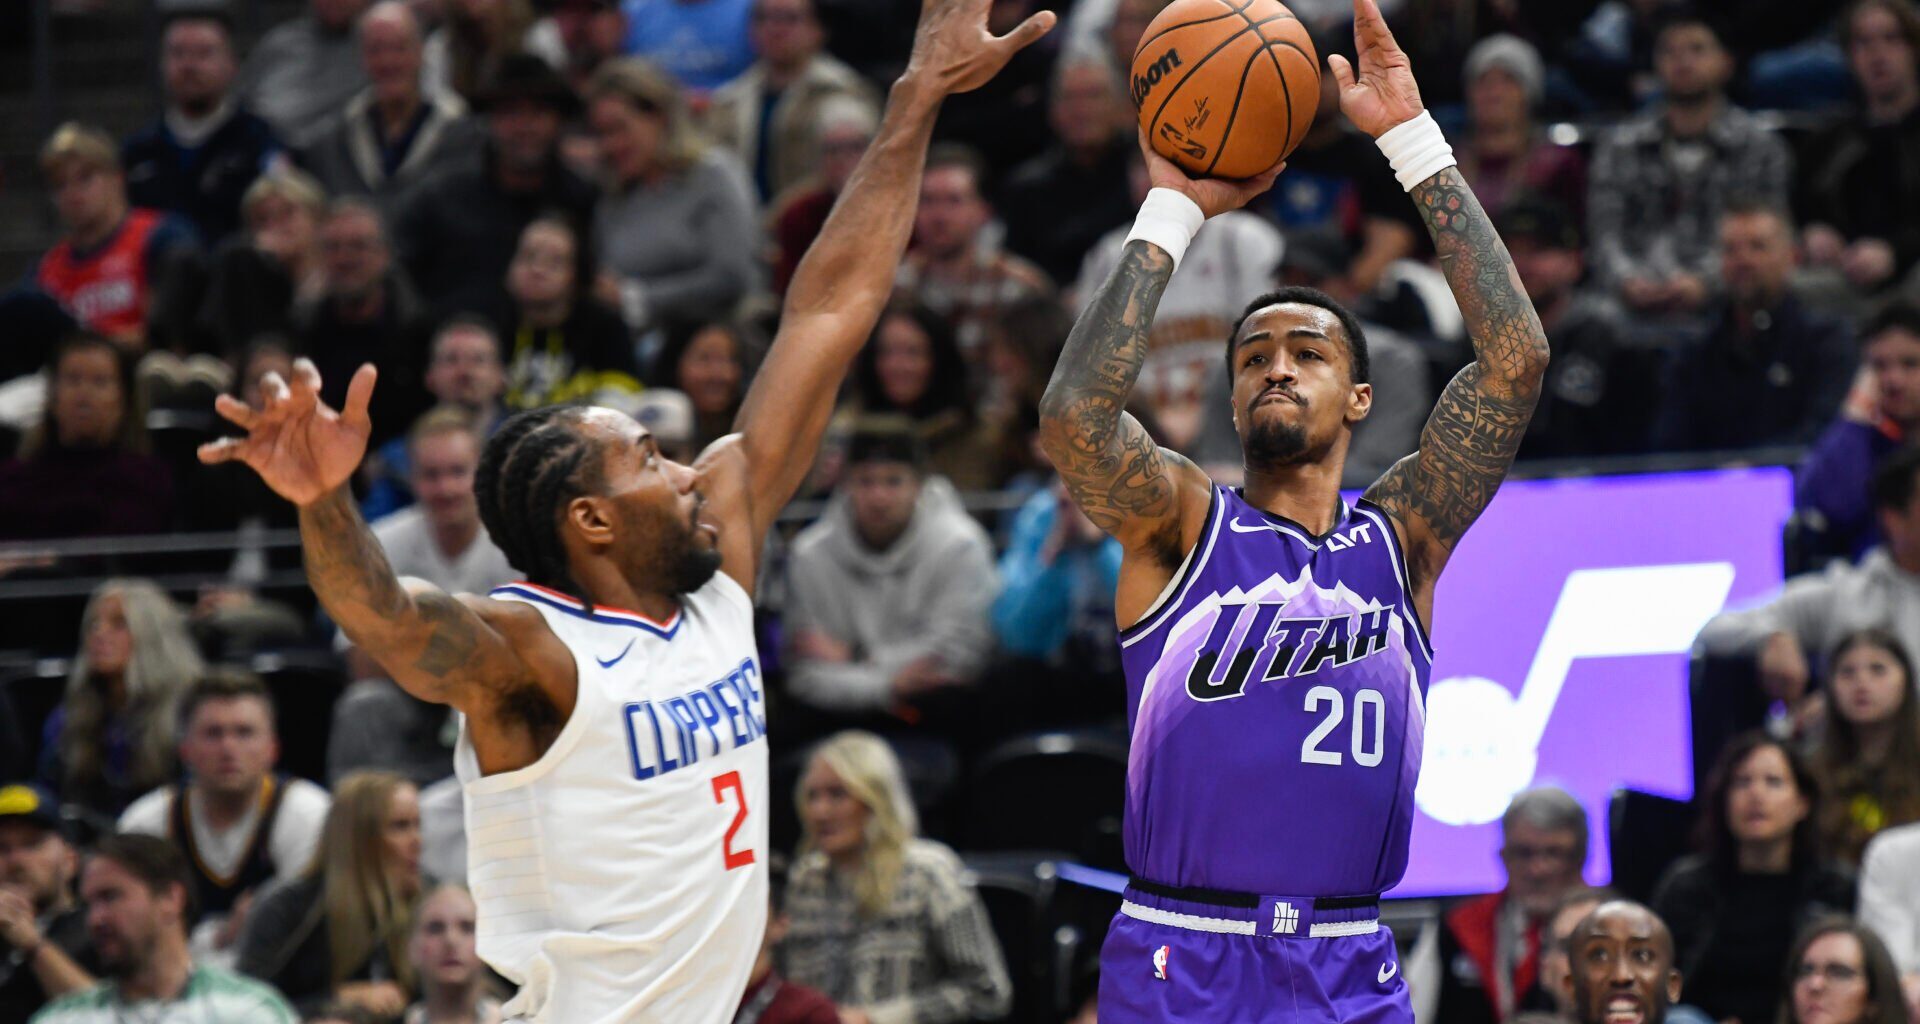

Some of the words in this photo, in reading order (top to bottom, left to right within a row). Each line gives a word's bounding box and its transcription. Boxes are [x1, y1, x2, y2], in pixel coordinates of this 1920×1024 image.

[1325, 522, 1372, 553] LVT
[1185, 600, 1395, 702] UTAH
[1300, 685, 1386, 768] 20
[711, 770, 756, 871] 2
